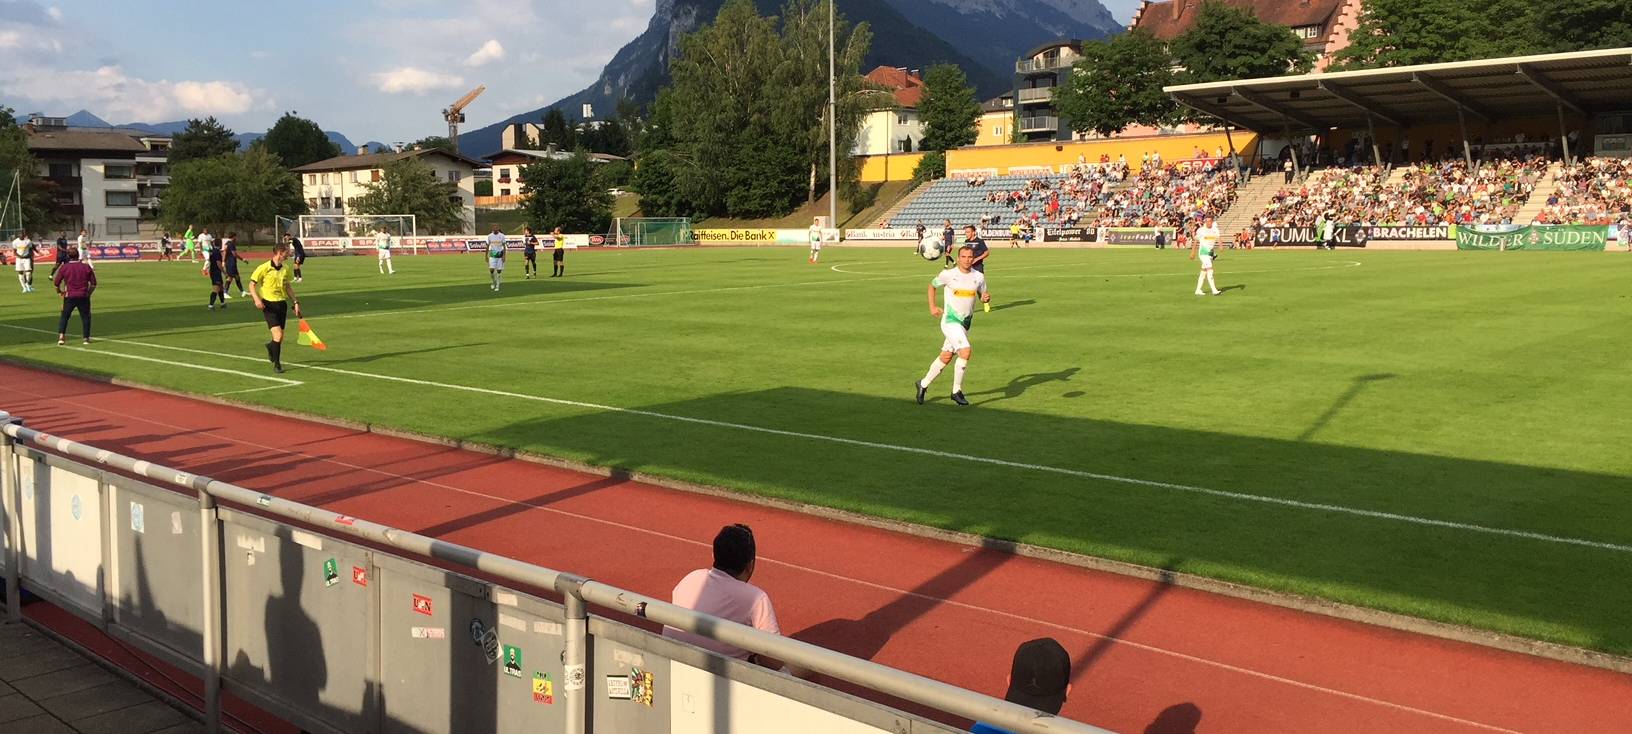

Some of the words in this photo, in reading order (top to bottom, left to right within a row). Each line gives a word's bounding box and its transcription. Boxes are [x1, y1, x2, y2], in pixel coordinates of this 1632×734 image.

[731, 230, 744, 241] Die
[745, 230, 767, 241] Bank
[1270, 228, 1352, 243] PUMUKL
[1373, 226, 1447, 239] BRACHELEN
[1544, 229, 1605, 245] SÜDEN
